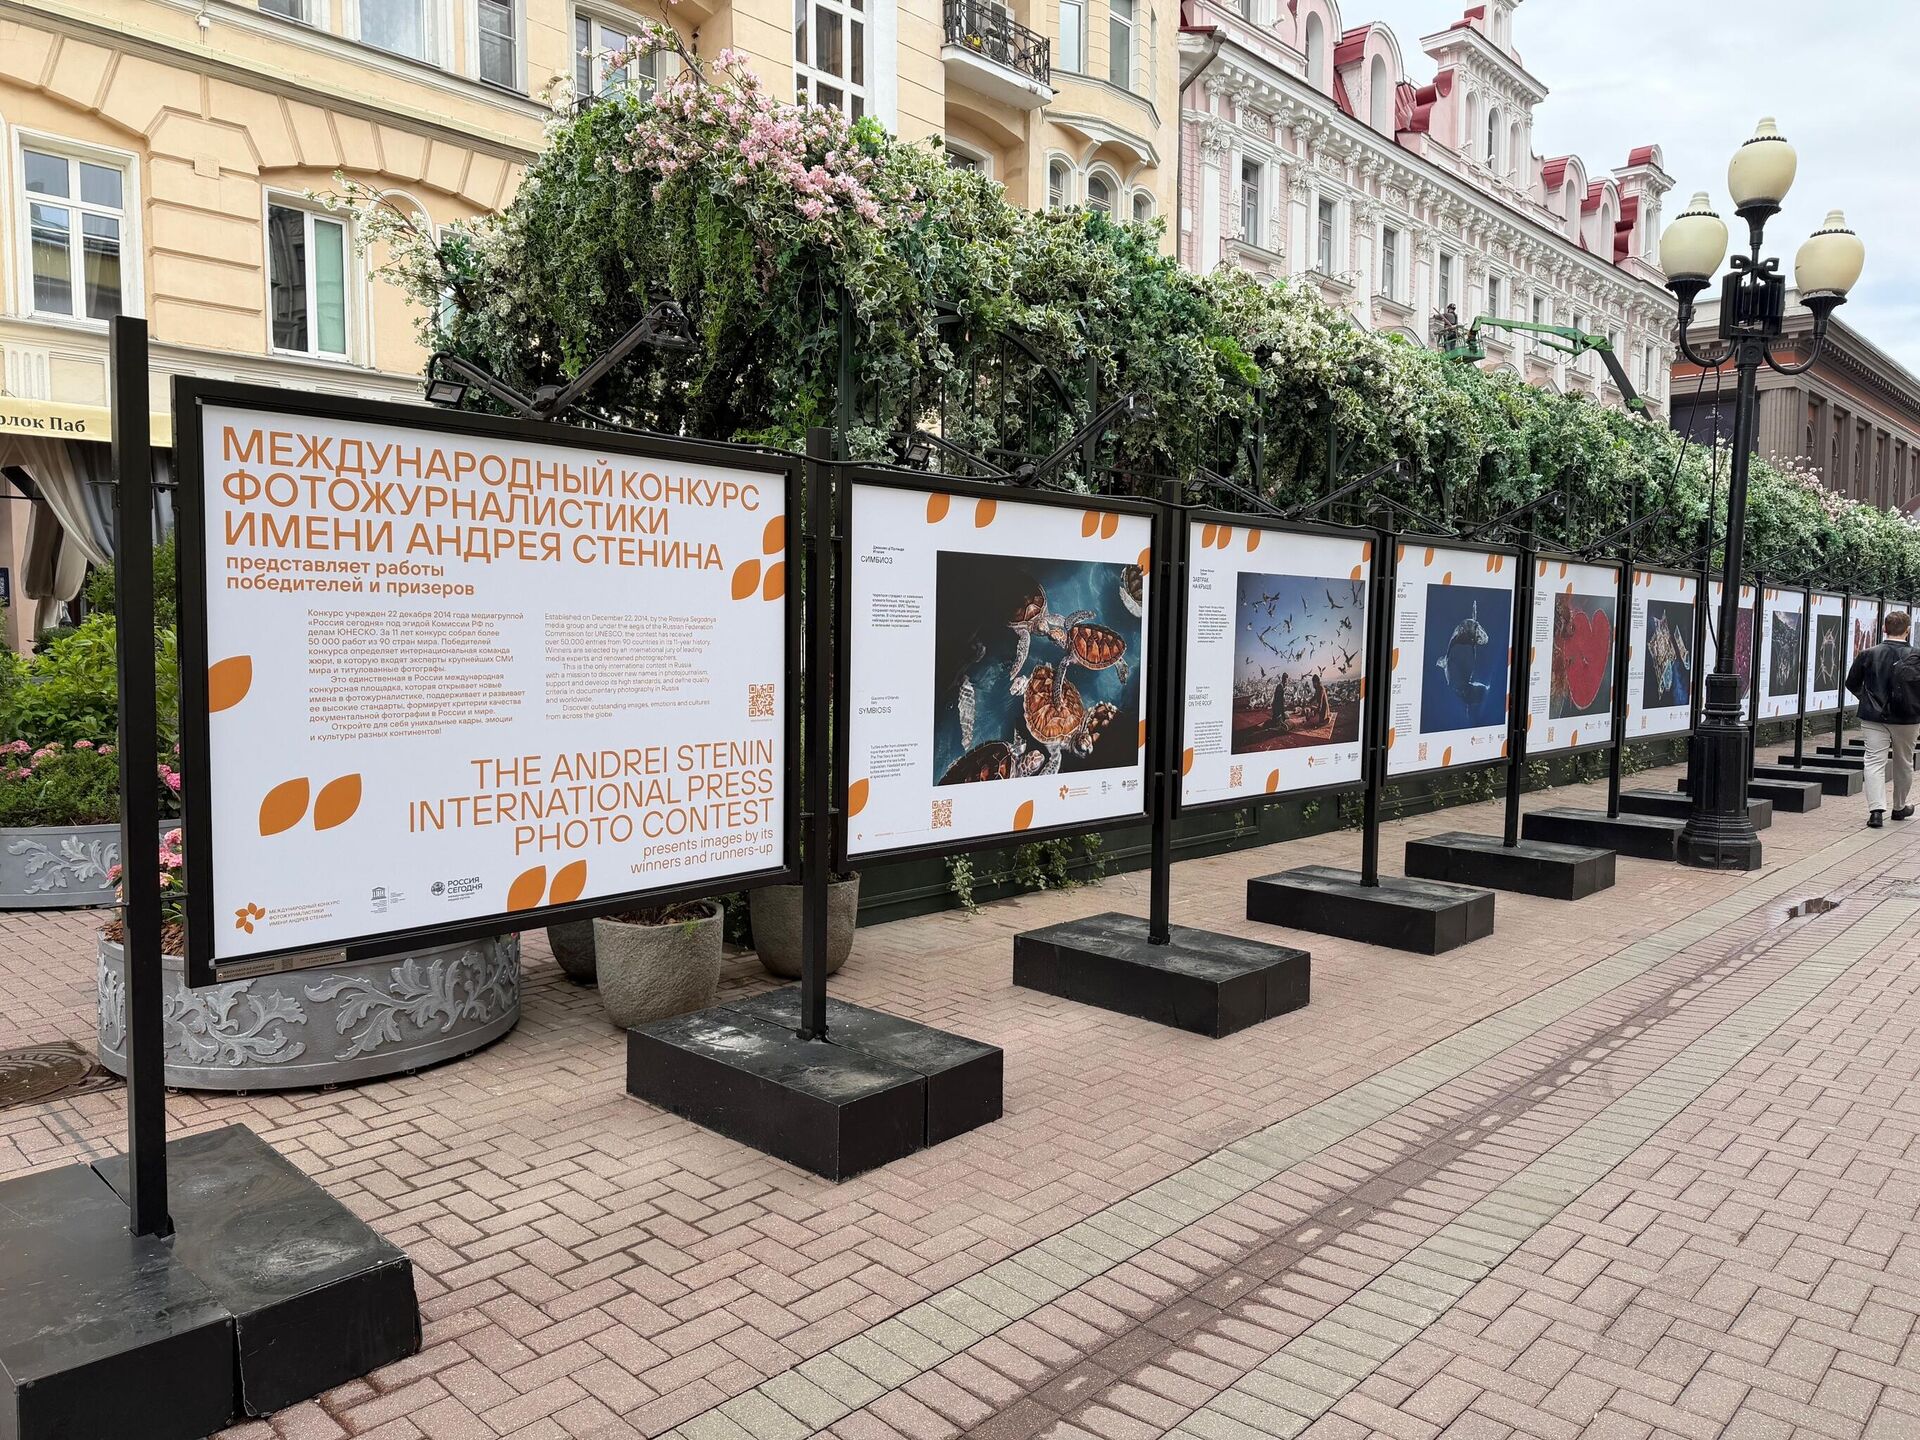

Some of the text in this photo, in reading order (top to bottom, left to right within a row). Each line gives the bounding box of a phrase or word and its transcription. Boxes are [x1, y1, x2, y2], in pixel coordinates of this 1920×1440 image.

[49, 416, 86, 433] Паб
[223, 427, 759, 511] МЕЖДУНАРОДНЫЙ КОНКУРС
[223, 469, 668, 535] ФОТОЖУРНАЛИСТИКИ
[225, 511, 723, 570] ИМЕНИ АНДРЕЯ СТЕНИНА
[860, 555, 893, 564] СИМБИОЗ
[227, 557, 443, 579] представляет работы
[227, 573, 474, 597] победителей и призеров
[308, 609, 343, 618] Конкурс
[399, 611, 432, 619] декабря
[308, 618, 344, 626] «Россия
[380, 628, 390, 636] За
[448, 629, 476, 637] собрал
[322, 638, 340, 646] 000
[342, 638, 366, 646] работ
[448, 656, 494, 664] крупнейших
[309, 686, 358, 694] конкурсная
[407, 701, 451, 710] формирует
[858, 706, 892, 715] SYMBIOSIS
[309, 712, 379, 723] документальной
[381, 711, 430, 720] фотографии
[331, 722, 372, 731] Откройте
[410, 719, 457, 728] уникальные
[318, 733, 356, 742] культуры
[358, 732, 388, 740] разных
[471, 739, 772, 789] THE ANDREI STENIN
[410, 769, 772, 832] INTERNATIONAL PRESS
[516, 798, 773, 855] PHOTO CONTEST
[644, 828, 773, 859] presents images by its
[631, 842, 772, 873] winners and runners-up
[448, 876, 480, 887] РОССИЯ
[448, 883, 483, 894] СЕГОДНЯ
[269, 903, 317, 914] МЕЖДУНАРОДНЫЙ
[269, 908, 325, 920] ФОТОЖУРНАЛИСТИКИ
[309, 913, 332, 921] СТЕНИНА
